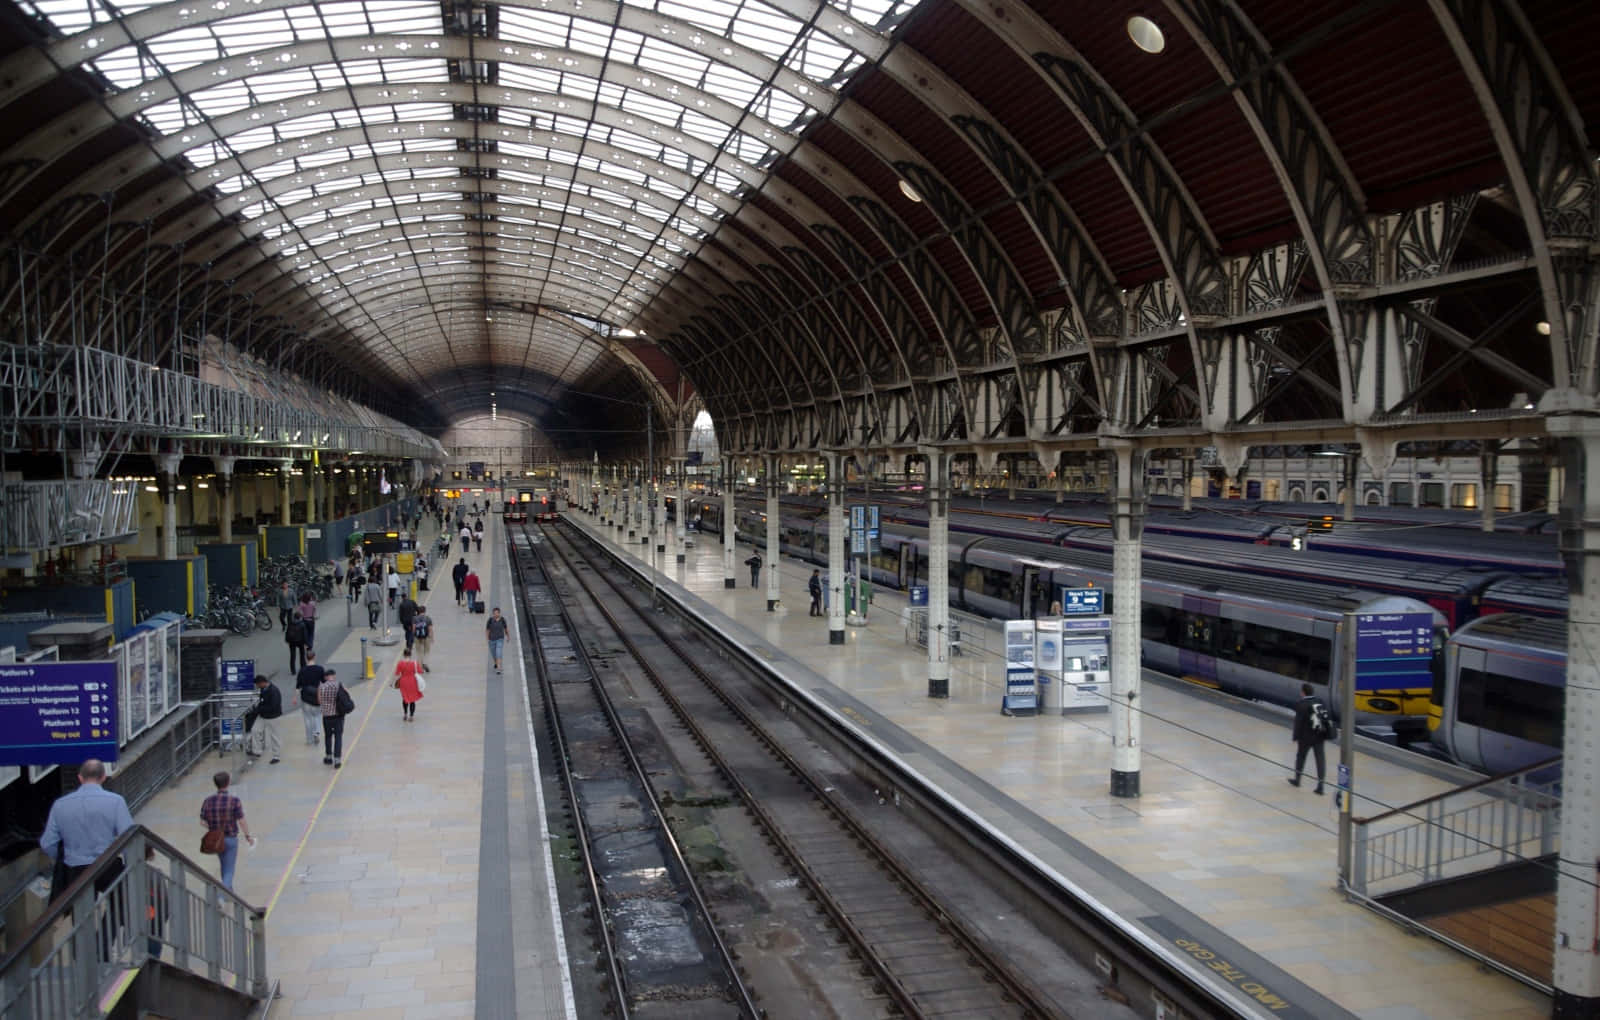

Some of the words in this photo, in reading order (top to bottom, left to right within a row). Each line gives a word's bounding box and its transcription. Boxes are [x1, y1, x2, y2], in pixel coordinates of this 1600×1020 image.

[1072, 596, 1079, 604] 9
[22, 684, 36, 692] and
[31, 695, 80, 704] Underground
[39, 707, 70, 716] Platform
[43, 718, 74, 727] Platform
[1175, 938, 1216, 961] GAP
[1206, 960, 1246, 982] THE
[1240, 983, 1289, 1009] MIND
